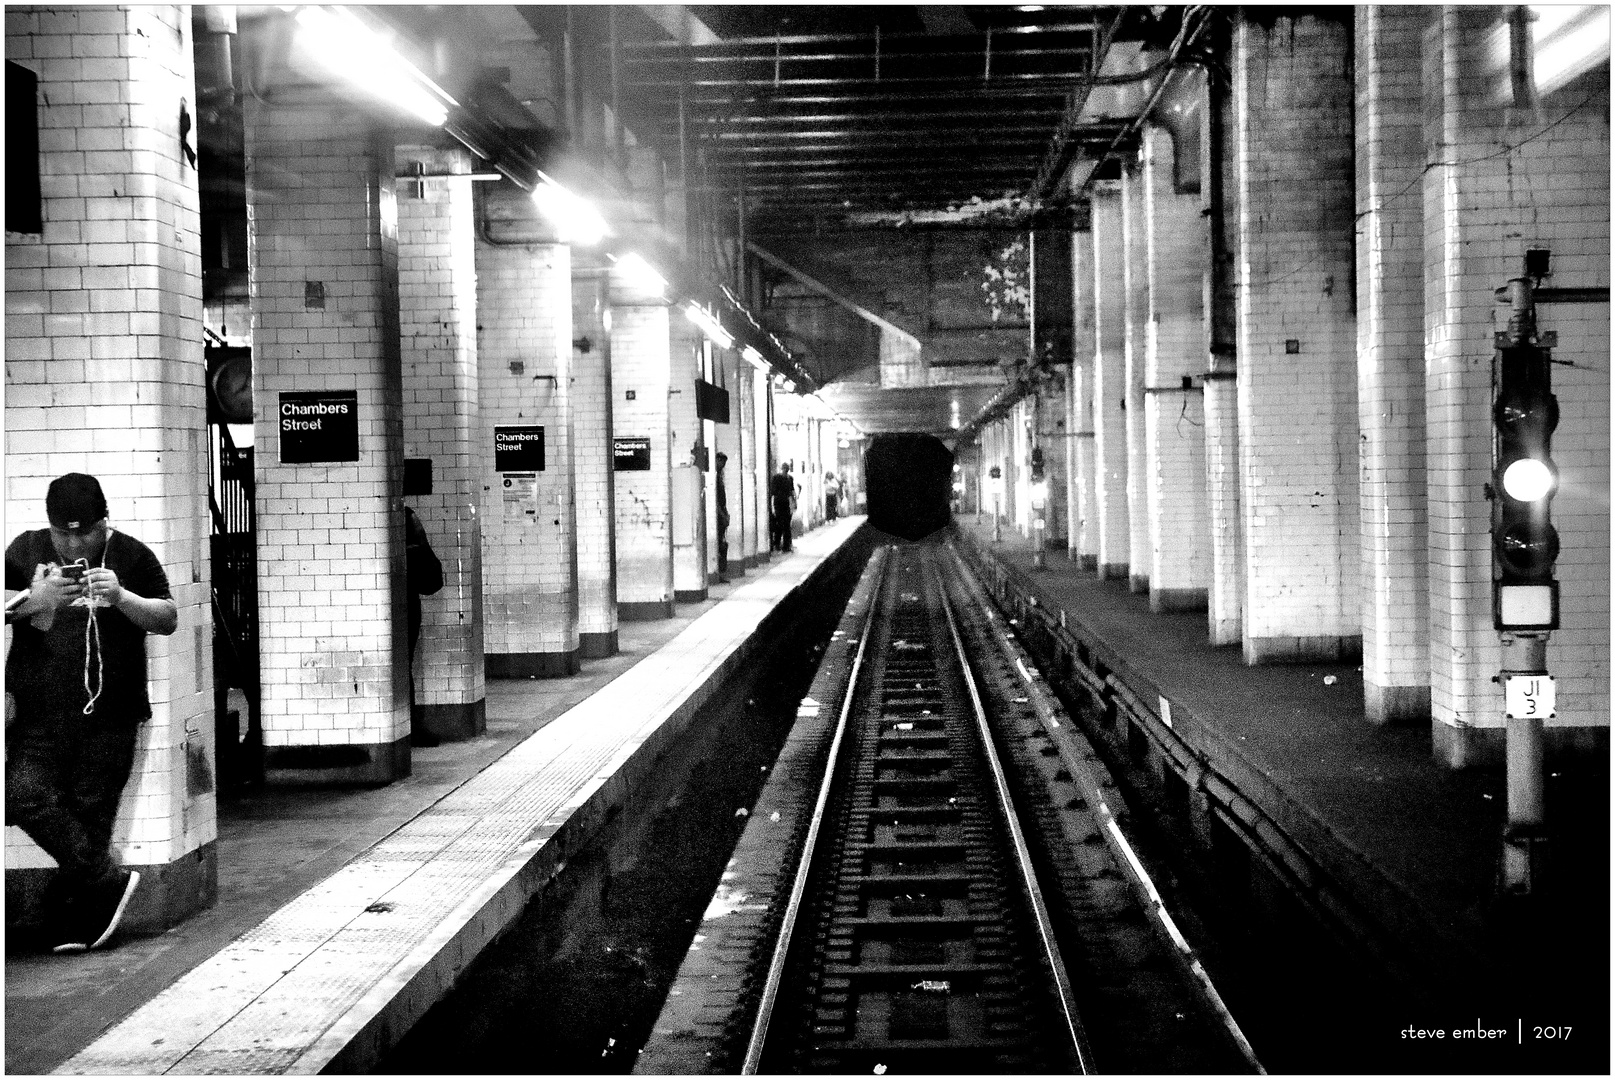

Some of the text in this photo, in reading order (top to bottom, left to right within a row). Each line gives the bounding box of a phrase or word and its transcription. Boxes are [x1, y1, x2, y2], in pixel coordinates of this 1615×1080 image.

[281, 402, 349, 416] Chambers
[282, 418, 322, 431] Street
[496, 433, 539, 441] Chambers
[496, 443, 522, 451] Street
[614, 442, 647, 450] Chambers
[1526, 698, 1536, 715] 3
